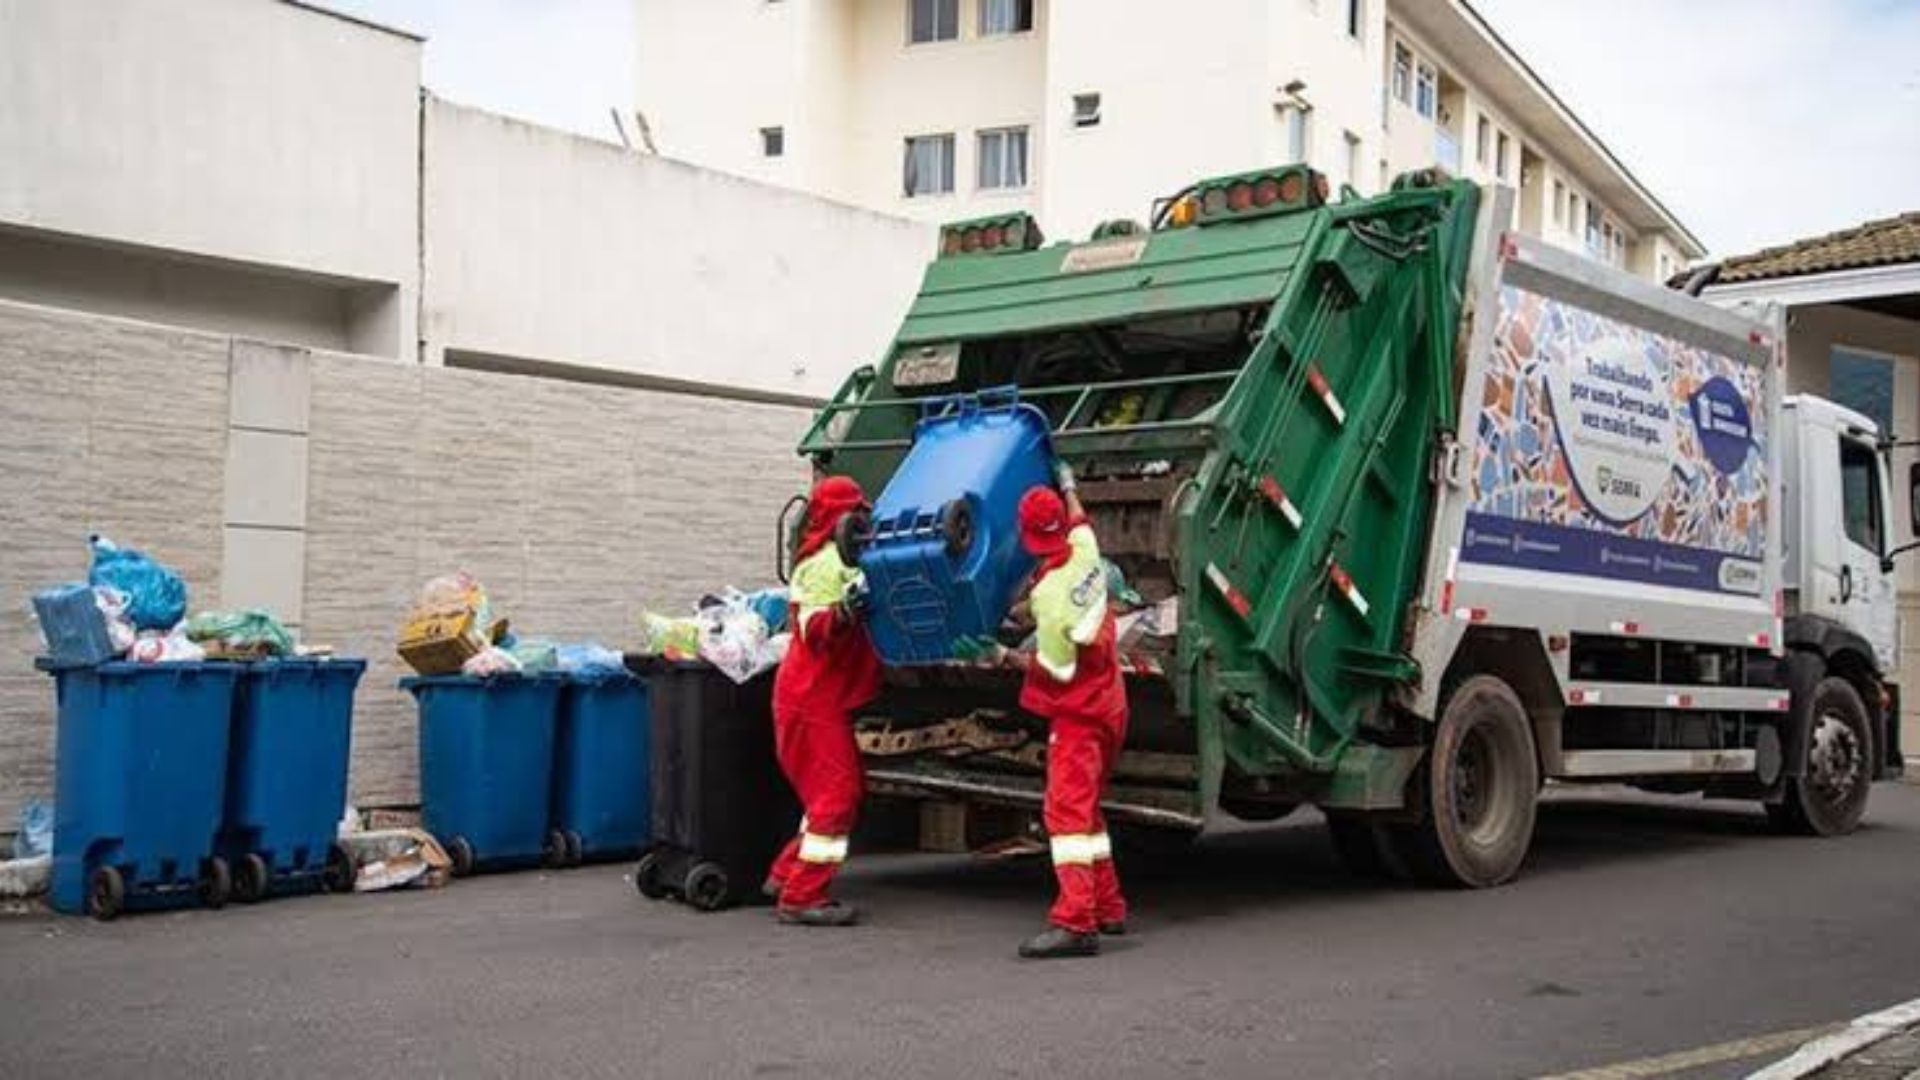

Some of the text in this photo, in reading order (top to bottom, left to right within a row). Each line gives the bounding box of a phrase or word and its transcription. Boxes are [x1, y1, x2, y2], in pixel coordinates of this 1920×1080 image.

[1585, 355, 1653, 393] Trabalhando
[1570, 382, 1670, 420] por uma Serra cada
[1582, 412, 1600, 429] vez
[1601, 413, 1628, 437] mais
